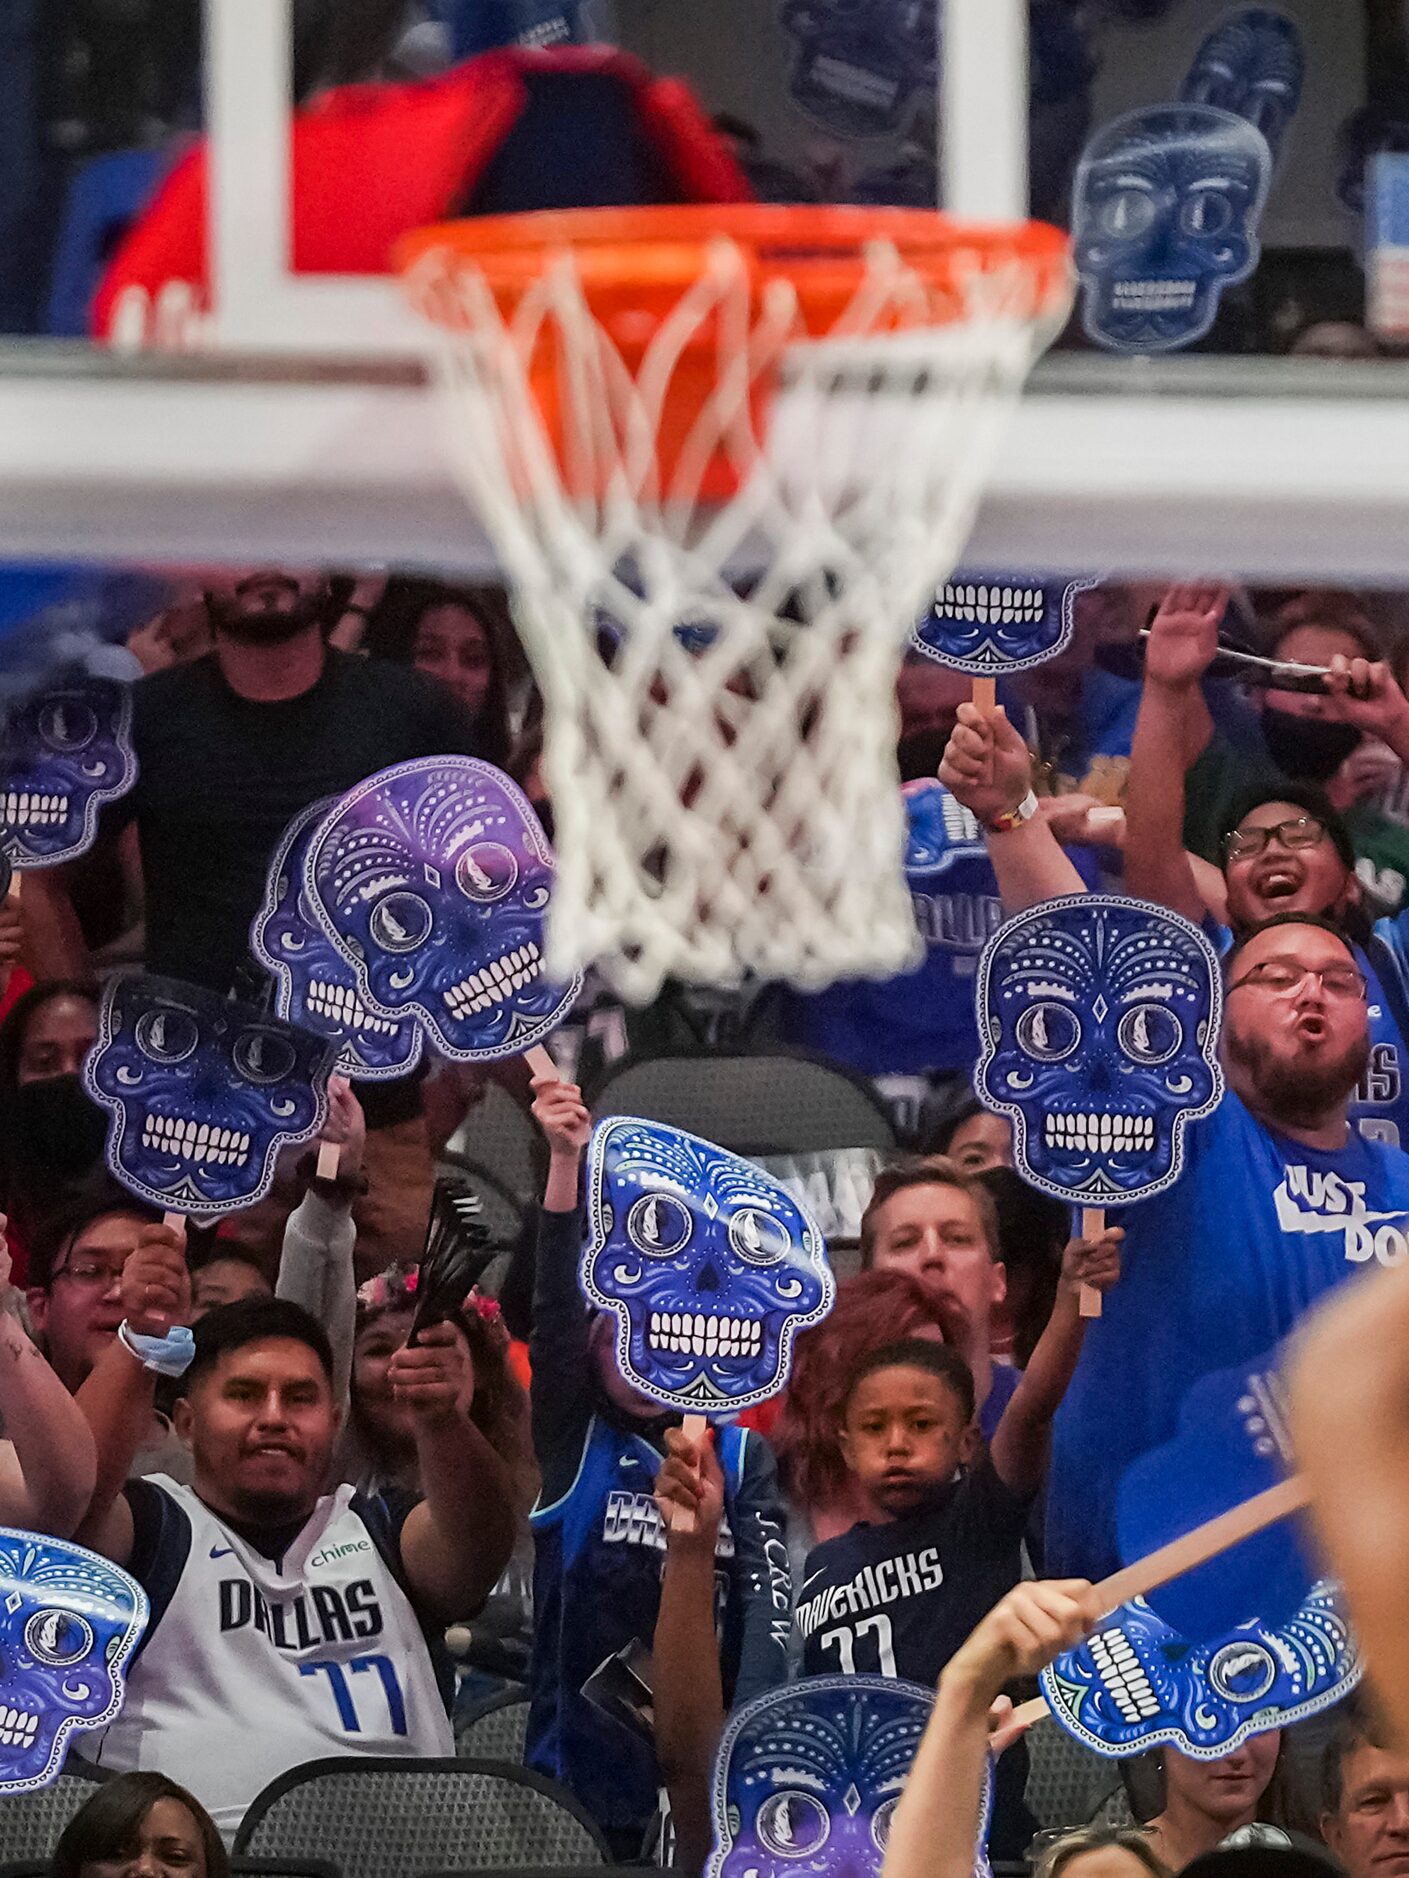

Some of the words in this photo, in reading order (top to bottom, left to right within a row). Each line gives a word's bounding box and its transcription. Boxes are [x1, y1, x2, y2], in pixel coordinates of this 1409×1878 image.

[1283, 1164, 1366, 1217] JUST
[311, 1540, 371, 1568] chime
[219, 1578, 385, 1651] DALLAS
[795, 1547, 944, 1640] MAVERICKS
[820, 1613, 898, 1679] 77
[299, 1654, 408, 1737] 77
